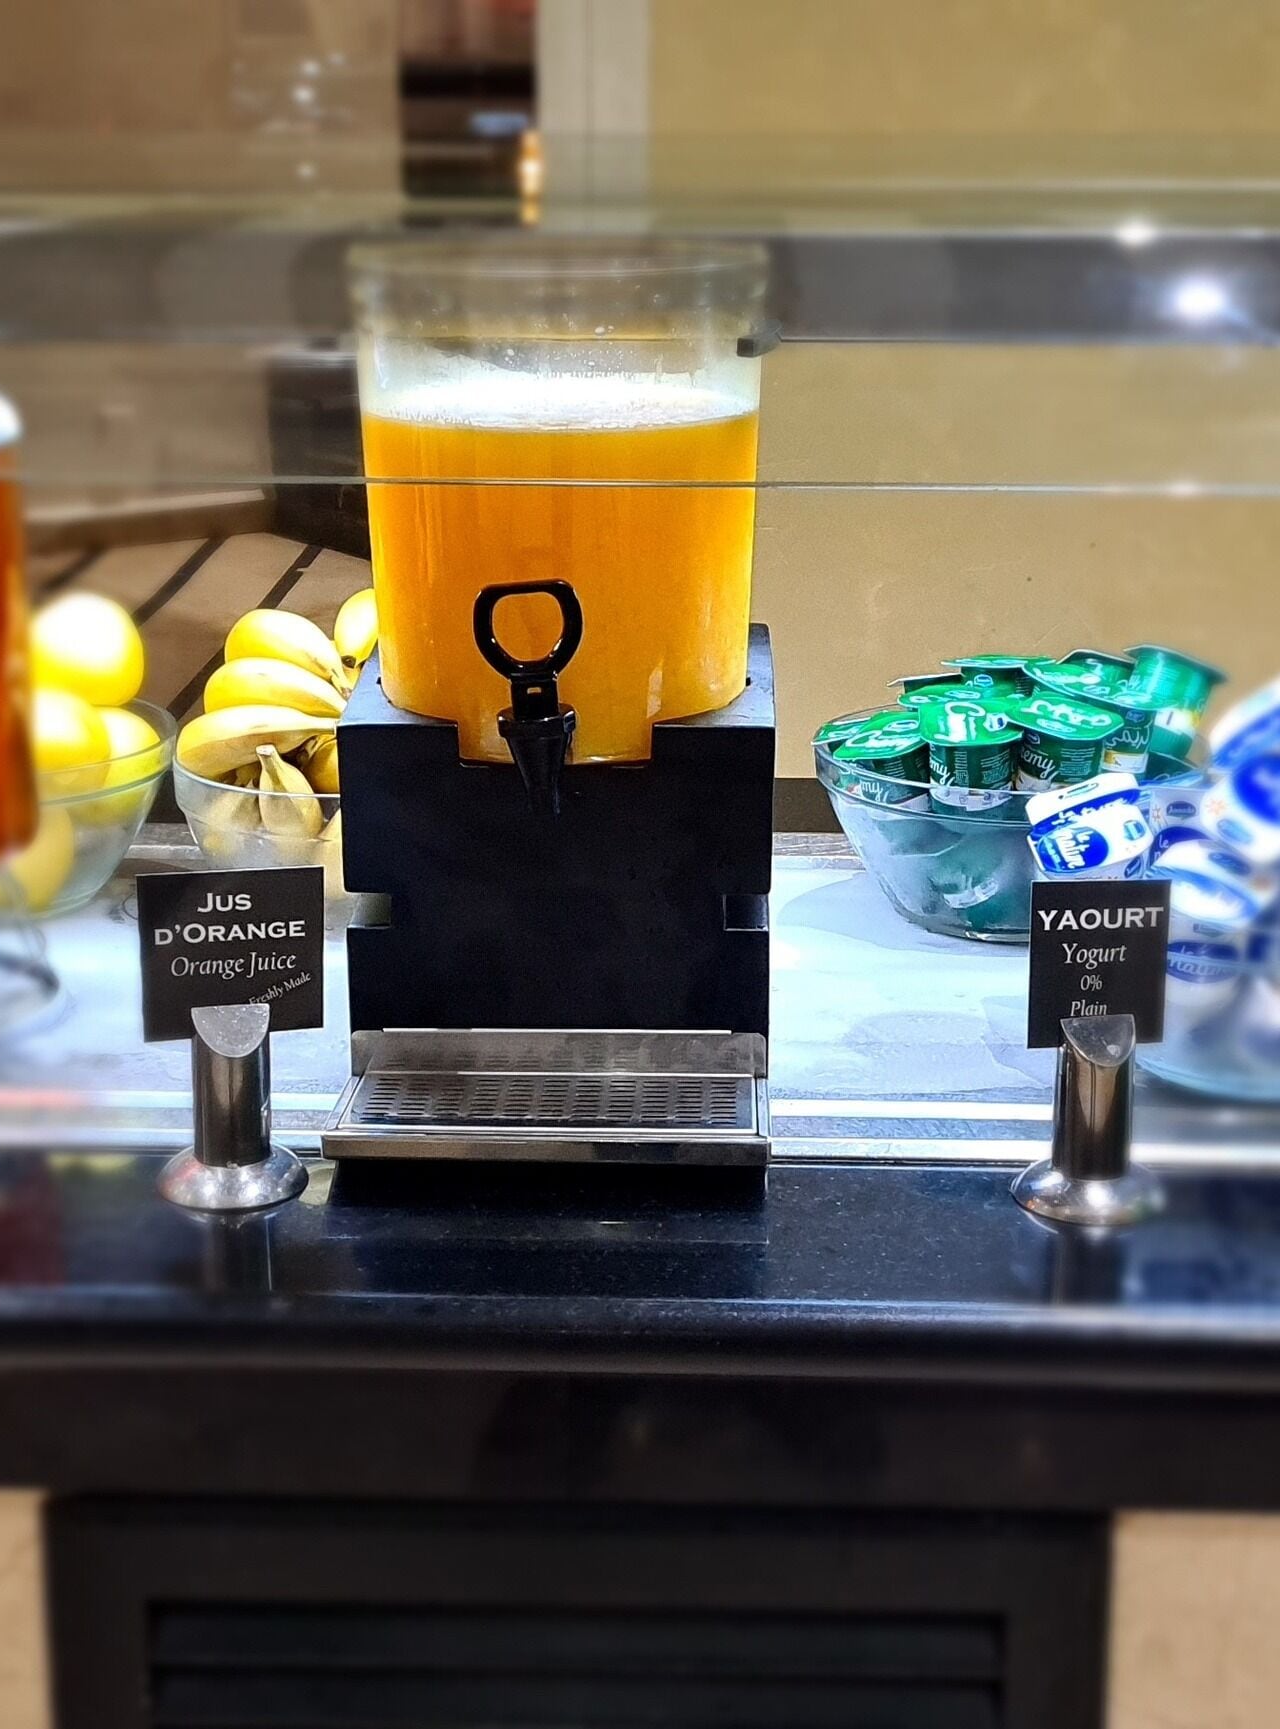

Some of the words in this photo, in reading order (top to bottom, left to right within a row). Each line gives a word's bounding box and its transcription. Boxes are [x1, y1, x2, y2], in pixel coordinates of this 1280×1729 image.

[197, 893, 252, 913] JUS
[1037, 906, 1164, 931] YAOURT
[154, 920, 306, 945] D'ORANGE
[171, 956, 244, 980] Orange
[246, 952, 297, 978] Juice
[1061, 943, 1127, 970] Yogurt
[248, 984, 284, 1006] Freshly
[283, 971, 312, 992] Made
[1080, 974, 1103, 992] 0%
[1070, 999, 1108, 1017] Plain
